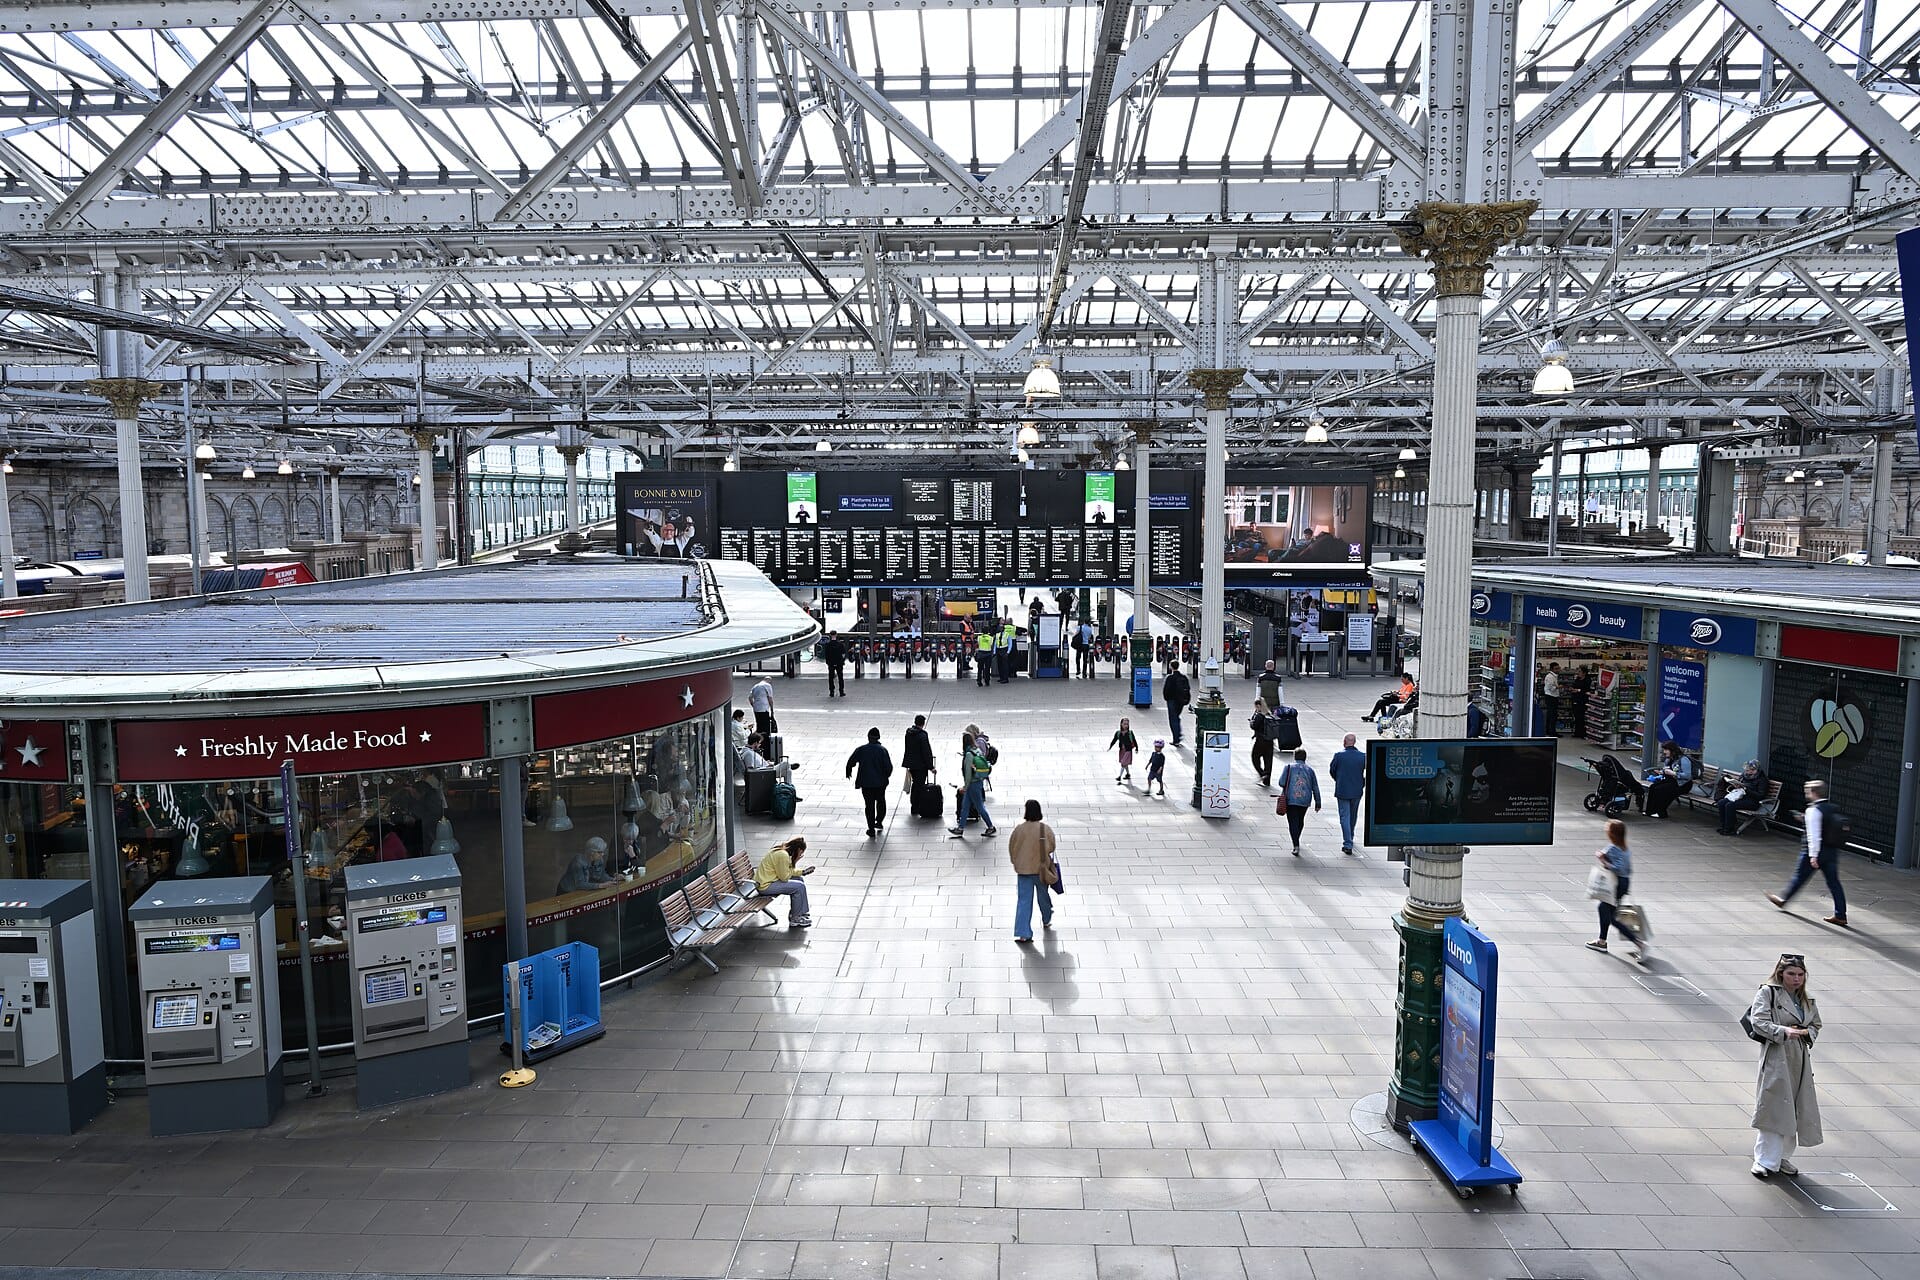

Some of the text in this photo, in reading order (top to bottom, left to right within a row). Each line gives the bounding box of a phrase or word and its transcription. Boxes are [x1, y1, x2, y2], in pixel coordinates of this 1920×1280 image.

[634, 489, 702, 498] BONNIE & WILD
[979, 600, 990, 609] 15
[1536, 606, 1626, 628] health Boots beauty
[1690, 624, 1713, 638] Boots
[1665, 664, 1700, 678] welcome
[1664, 676, 1687, 684] healthcare
[200, 726, 407, 759] Freshly Made Food
[1389, 747, 1423, 756] SEE IT.
[1389, 757, 1423, 766] SAY IT.
[1389, 766, 1436, 776] SORTED.
[632, 876, 672, 896] SALADS JUICES
[386, 891, 427, 904] Tickets
[536, 898, 611, 925] FLAT WHITE TOASTIES
[175, 916, 218, 926] Tickets
[472, 930, 487, 938] TEA
[1448, 933, 1472, 966] lumo
